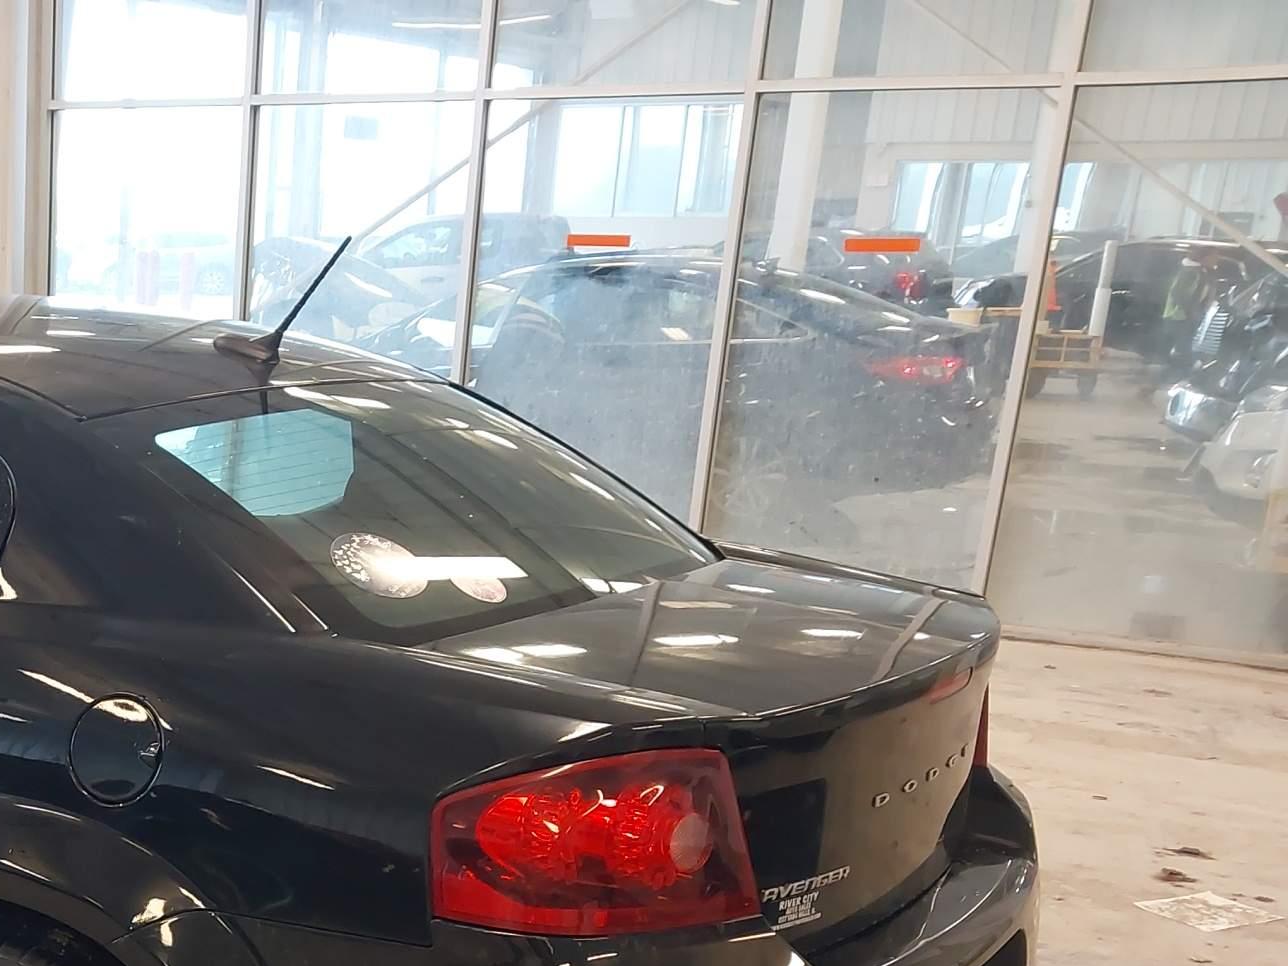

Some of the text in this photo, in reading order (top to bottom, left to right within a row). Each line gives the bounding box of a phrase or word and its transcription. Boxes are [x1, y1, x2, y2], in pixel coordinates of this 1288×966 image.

[762, 865, 851, 903] AVENGER
[779, 891, 819, 911] RIVER CITY
